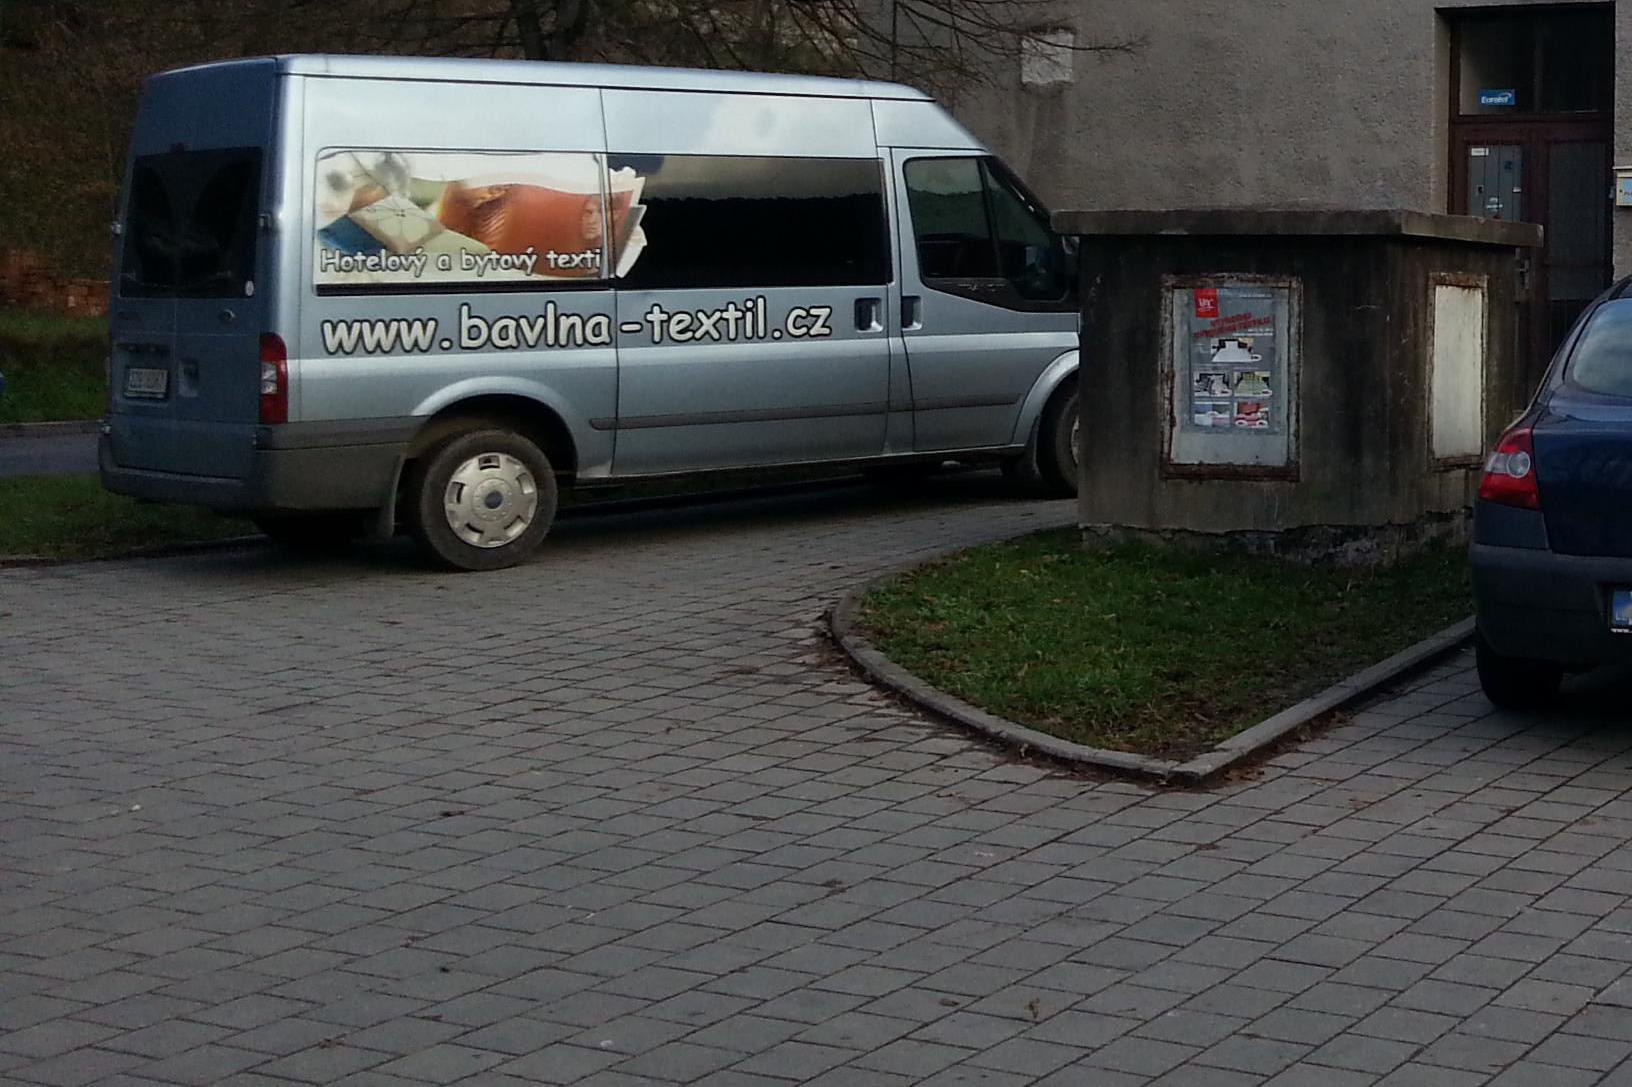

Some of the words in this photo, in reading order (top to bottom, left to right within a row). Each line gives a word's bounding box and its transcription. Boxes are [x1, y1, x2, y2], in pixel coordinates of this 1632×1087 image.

[320, 247, 427, 277] Hotelový
[435, 254, 453, 272] a
[460, 246, 538, 277] bytový
[320, 296, 834, 355] www.bavlna-textil.cz
